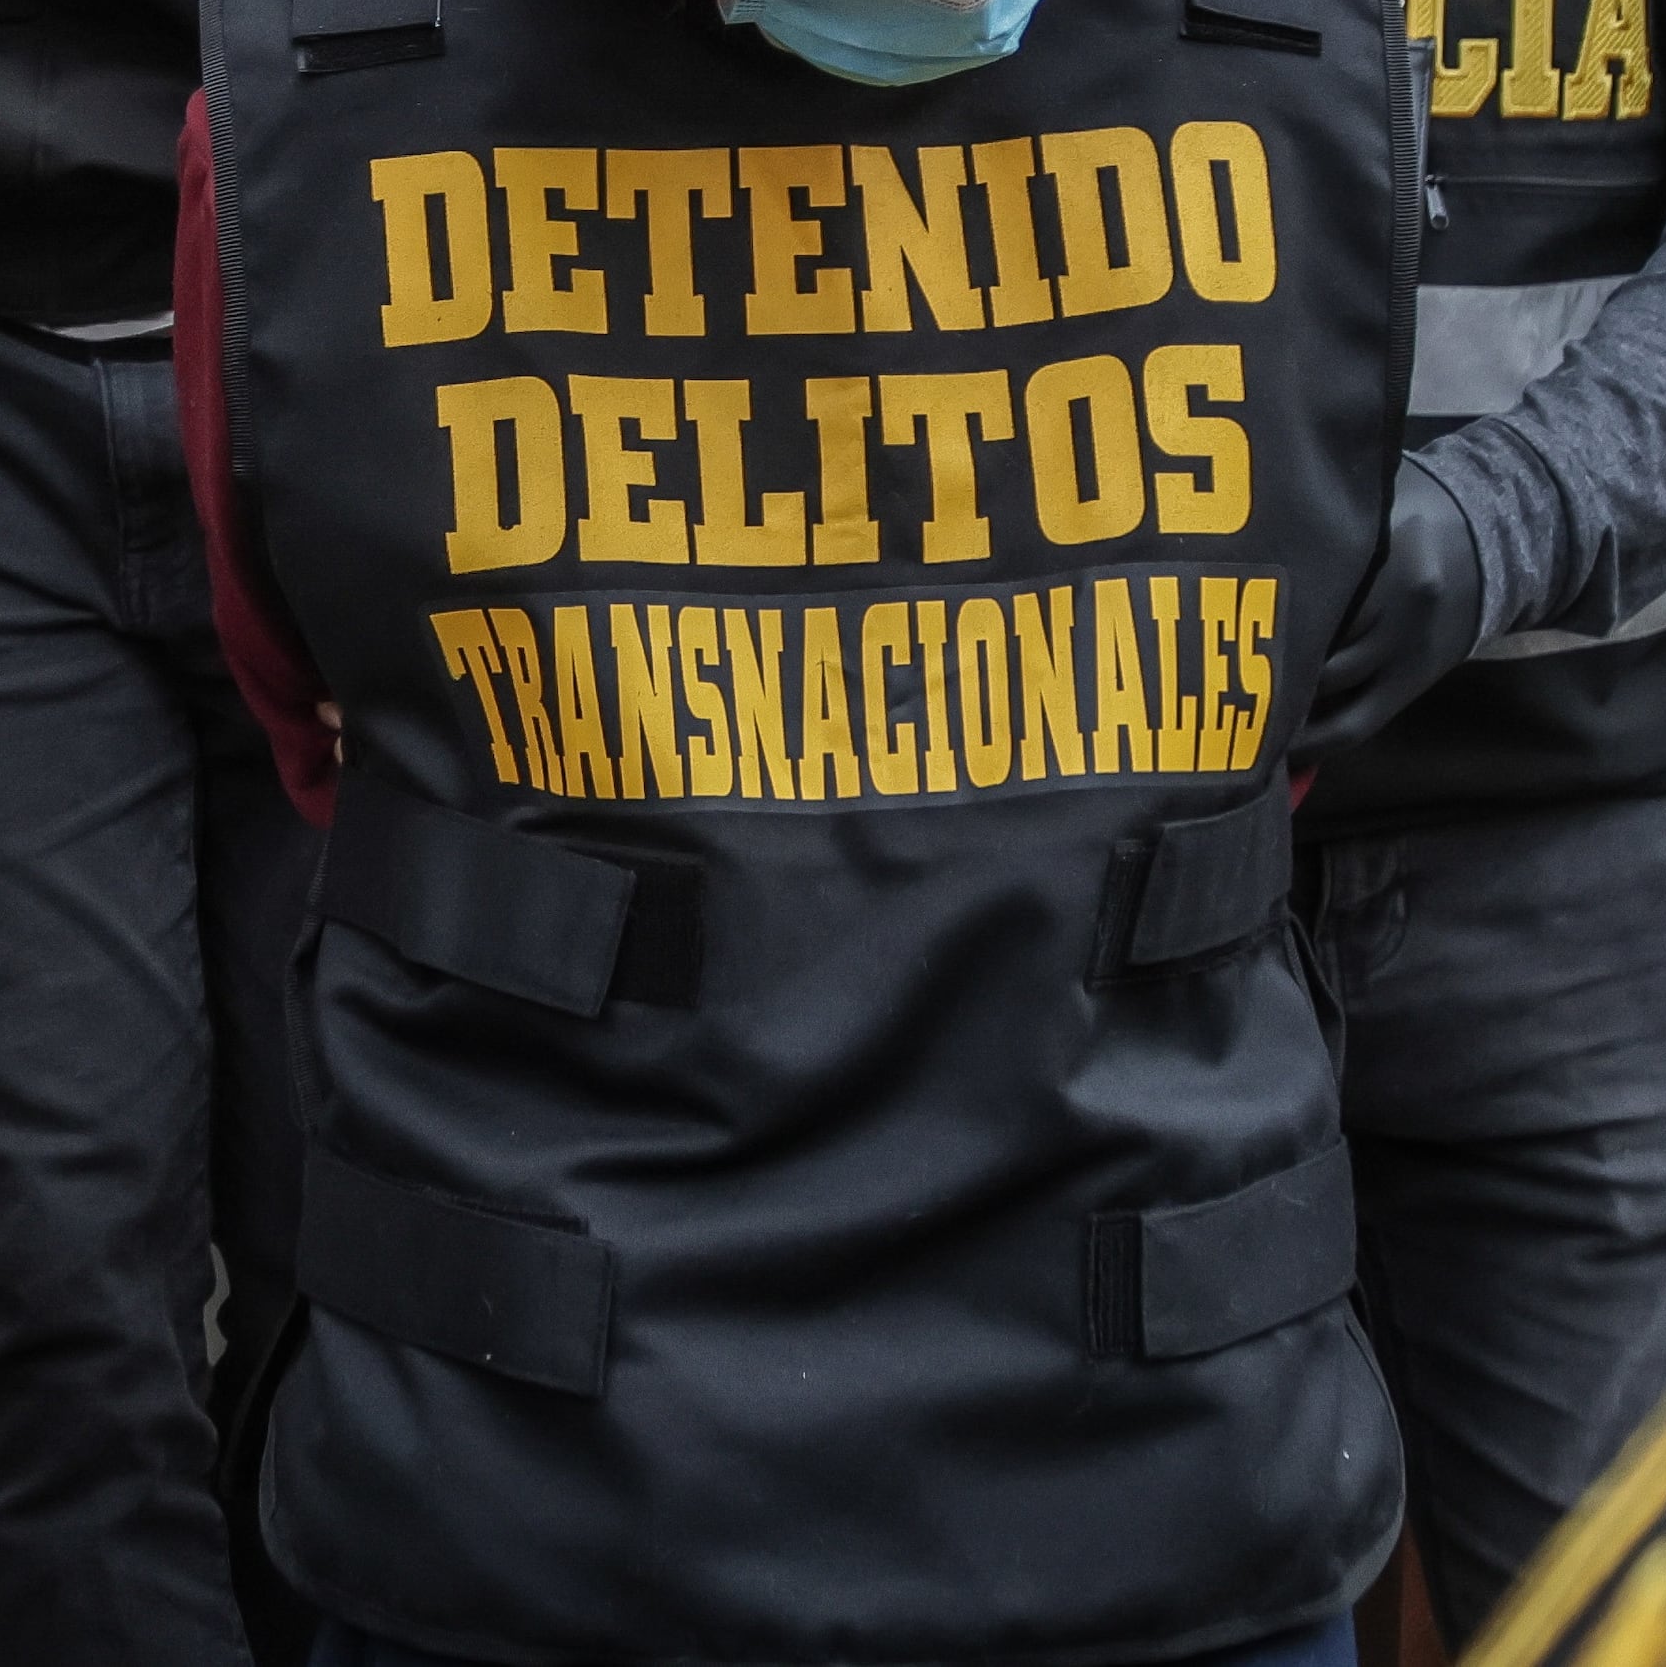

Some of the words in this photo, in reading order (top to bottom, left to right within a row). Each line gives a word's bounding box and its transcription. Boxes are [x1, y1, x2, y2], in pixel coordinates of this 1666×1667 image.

[369, 120, 1277, 348] DETENIDO
[436, 343, 1253, 575] DELITOS
[428, 574, 1279, 801] TRANSNACIONALES
